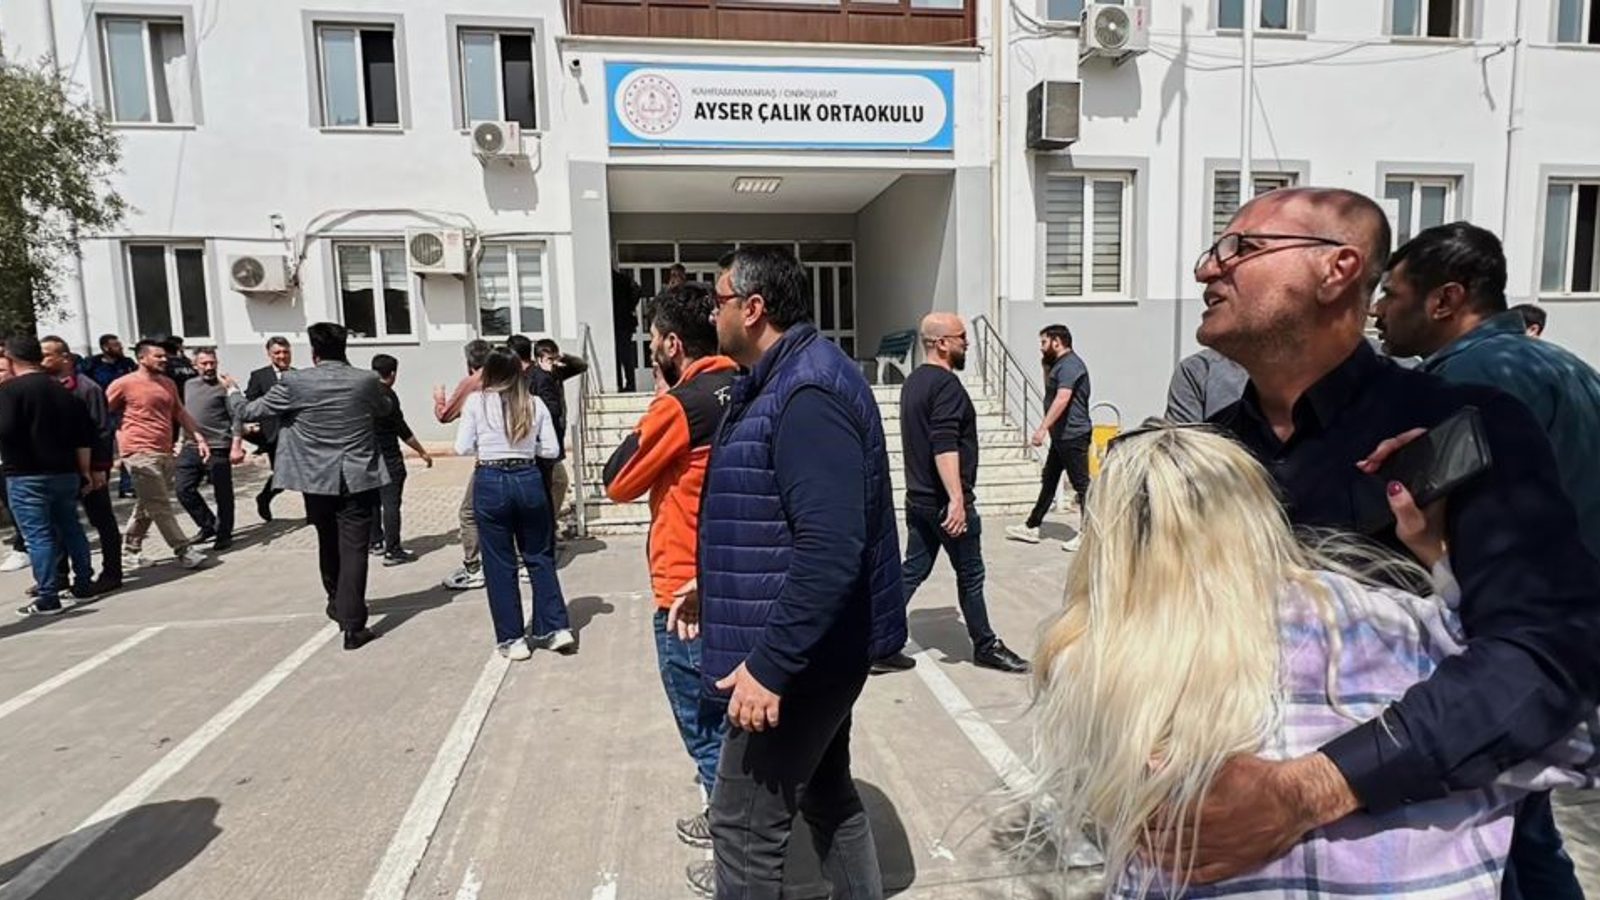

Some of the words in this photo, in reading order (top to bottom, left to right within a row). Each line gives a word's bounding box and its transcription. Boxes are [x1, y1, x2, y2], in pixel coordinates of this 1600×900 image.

[694, 102, 753, 120] AYSER
[758, 103, 812, 123] ÇALIK
[817, 104, 924, 122] ORTAOKULU
